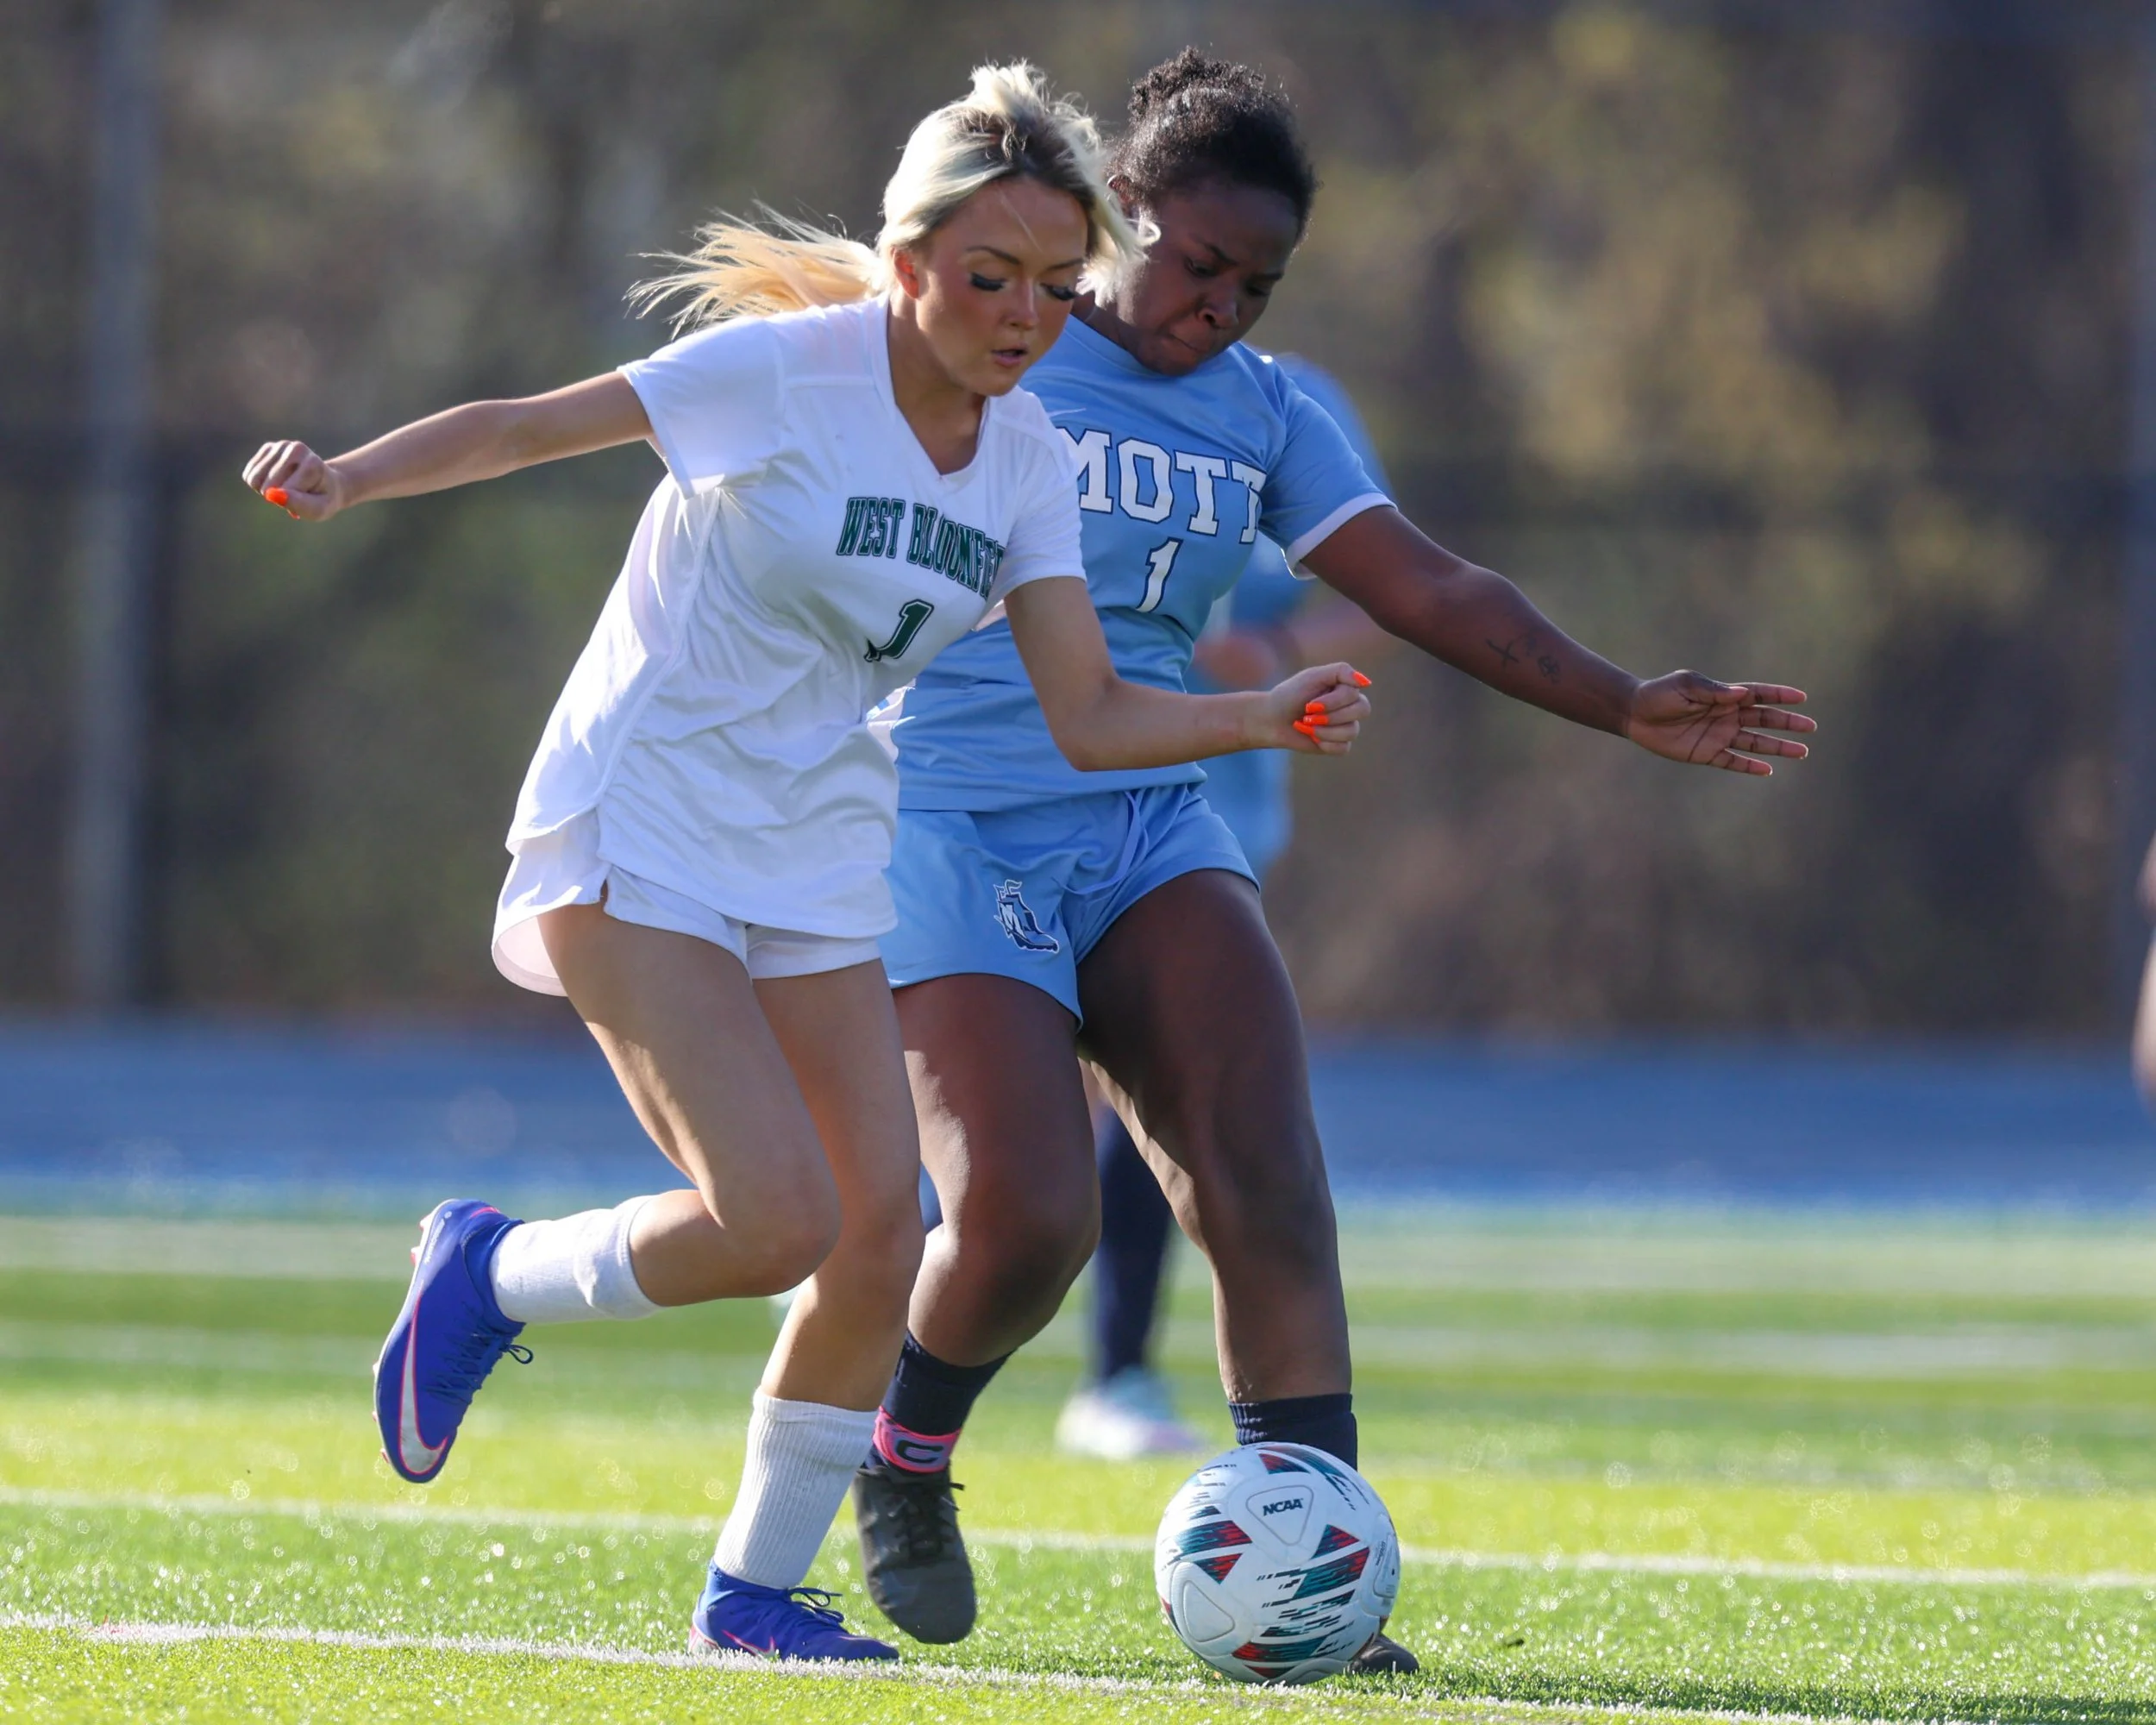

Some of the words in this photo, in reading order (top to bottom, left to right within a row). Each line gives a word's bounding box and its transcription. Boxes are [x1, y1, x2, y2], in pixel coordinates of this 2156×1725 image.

[1055, 426, 1268, 545] MOTT
[837, 497, 906, 559] WEST
[1135, 536, 1184, 613] 1
[864, 599, 935, 662] 1
[1263, 1498, 1303, 1516] NCAA
